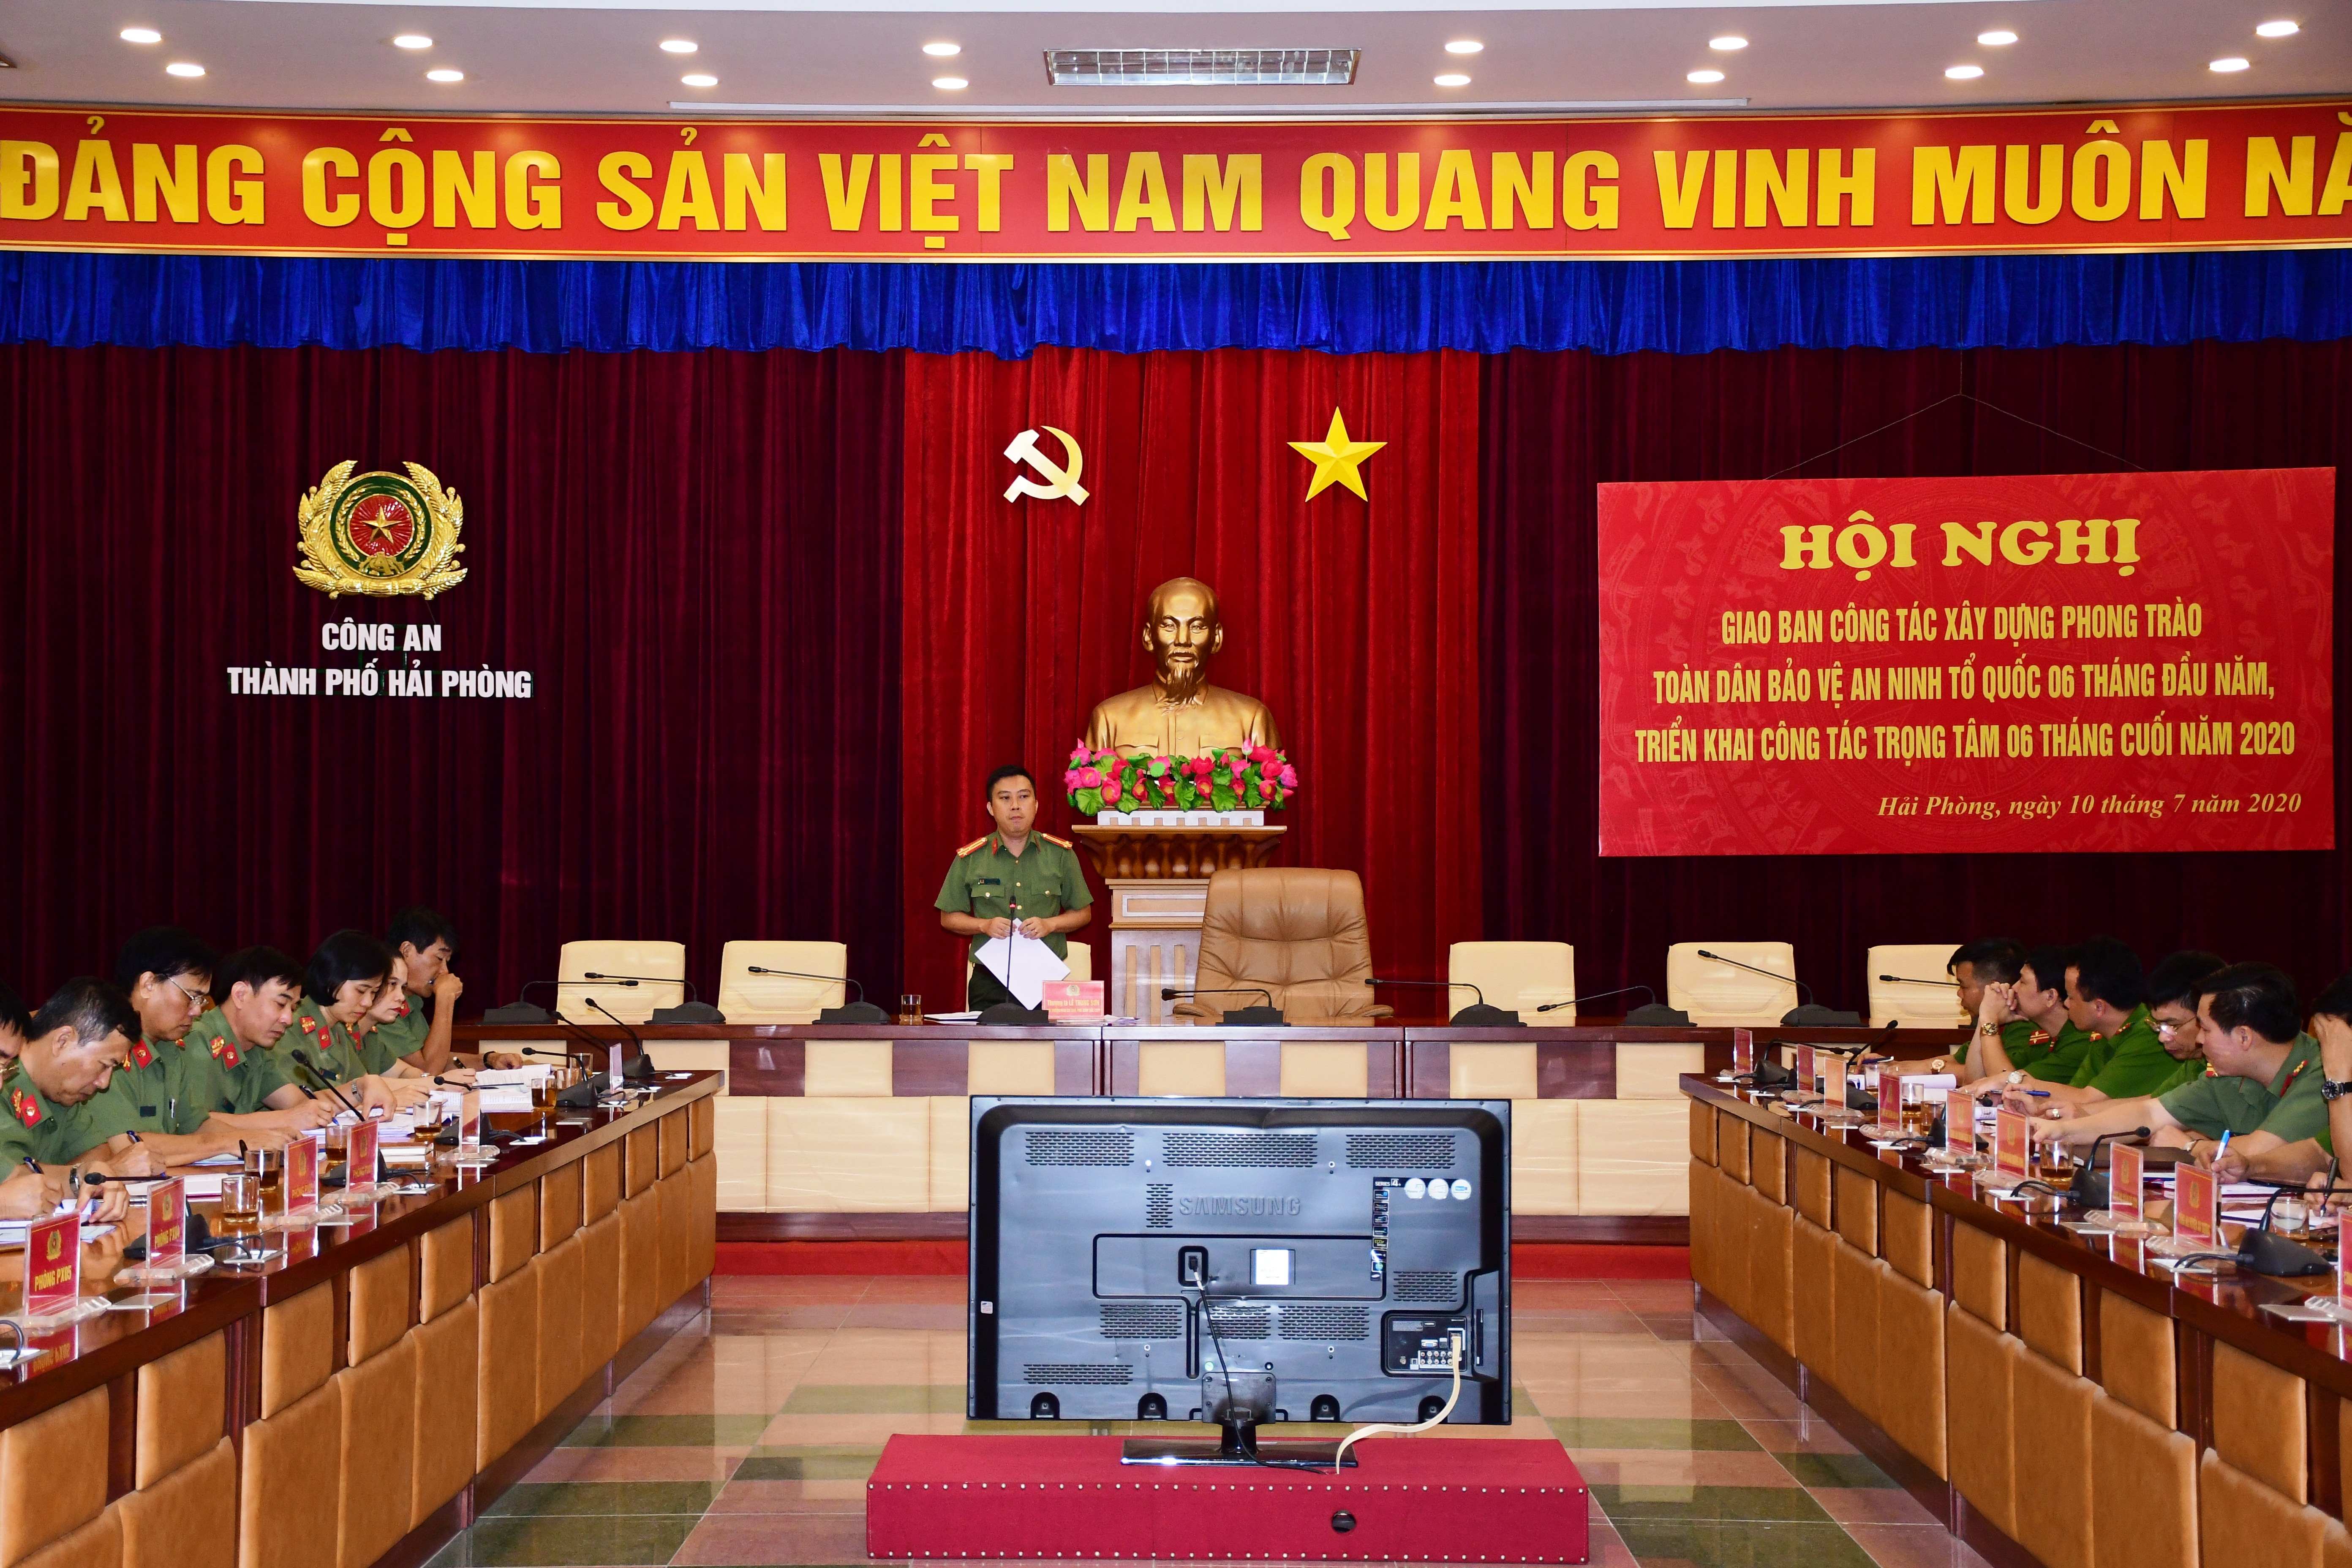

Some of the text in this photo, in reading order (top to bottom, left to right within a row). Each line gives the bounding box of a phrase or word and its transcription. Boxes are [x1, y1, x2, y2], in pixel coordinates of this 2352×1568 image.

[0, 116, 264, 225] ĐẢNG
[302, 128, 562, 246] CỘNG
[596, 127, 787, 231] SẢN
[818, 133, 1014, 248] VIỆT
[1047, 152, 1263, 232] NAM
[1300, 150, 1620, 241] QUANG
[1653, 148, 1876, 229] VINH
[1911, 120, 2209, 225] MUÔN
[1780, 510, 2140, 581] HỘI NGHỊ
[322, 617, 441, 651] CÔNG AN
[1722, 596, 2202, 647] GIAO BAN CÔNG TÁC XÂY DỰNG PHONG TRÀO
[227, 658, 531, 698] THÀNH PHỐ HẢI PHÒNG
[1654, 651, 2274, 708] TOÀN DÂN BẢO VỆ AN NINH TỔ QUỐC 06 THÁNG ĐẦU NĂM,
[1635, 710, 2295, 766] TRIỂN KHAI CÔNG TÁC TRỌNG TÂM 06 THÁNG CUỐI NĂM 2020
[1877, 793, 2302, 820] Hải Phòng, ngày 10 tháng 7 năm 2020
[1179, 1196, 1300, 1216] SAMSUNG
[35, 1265, 72, 1292] PHÒNG PX05
